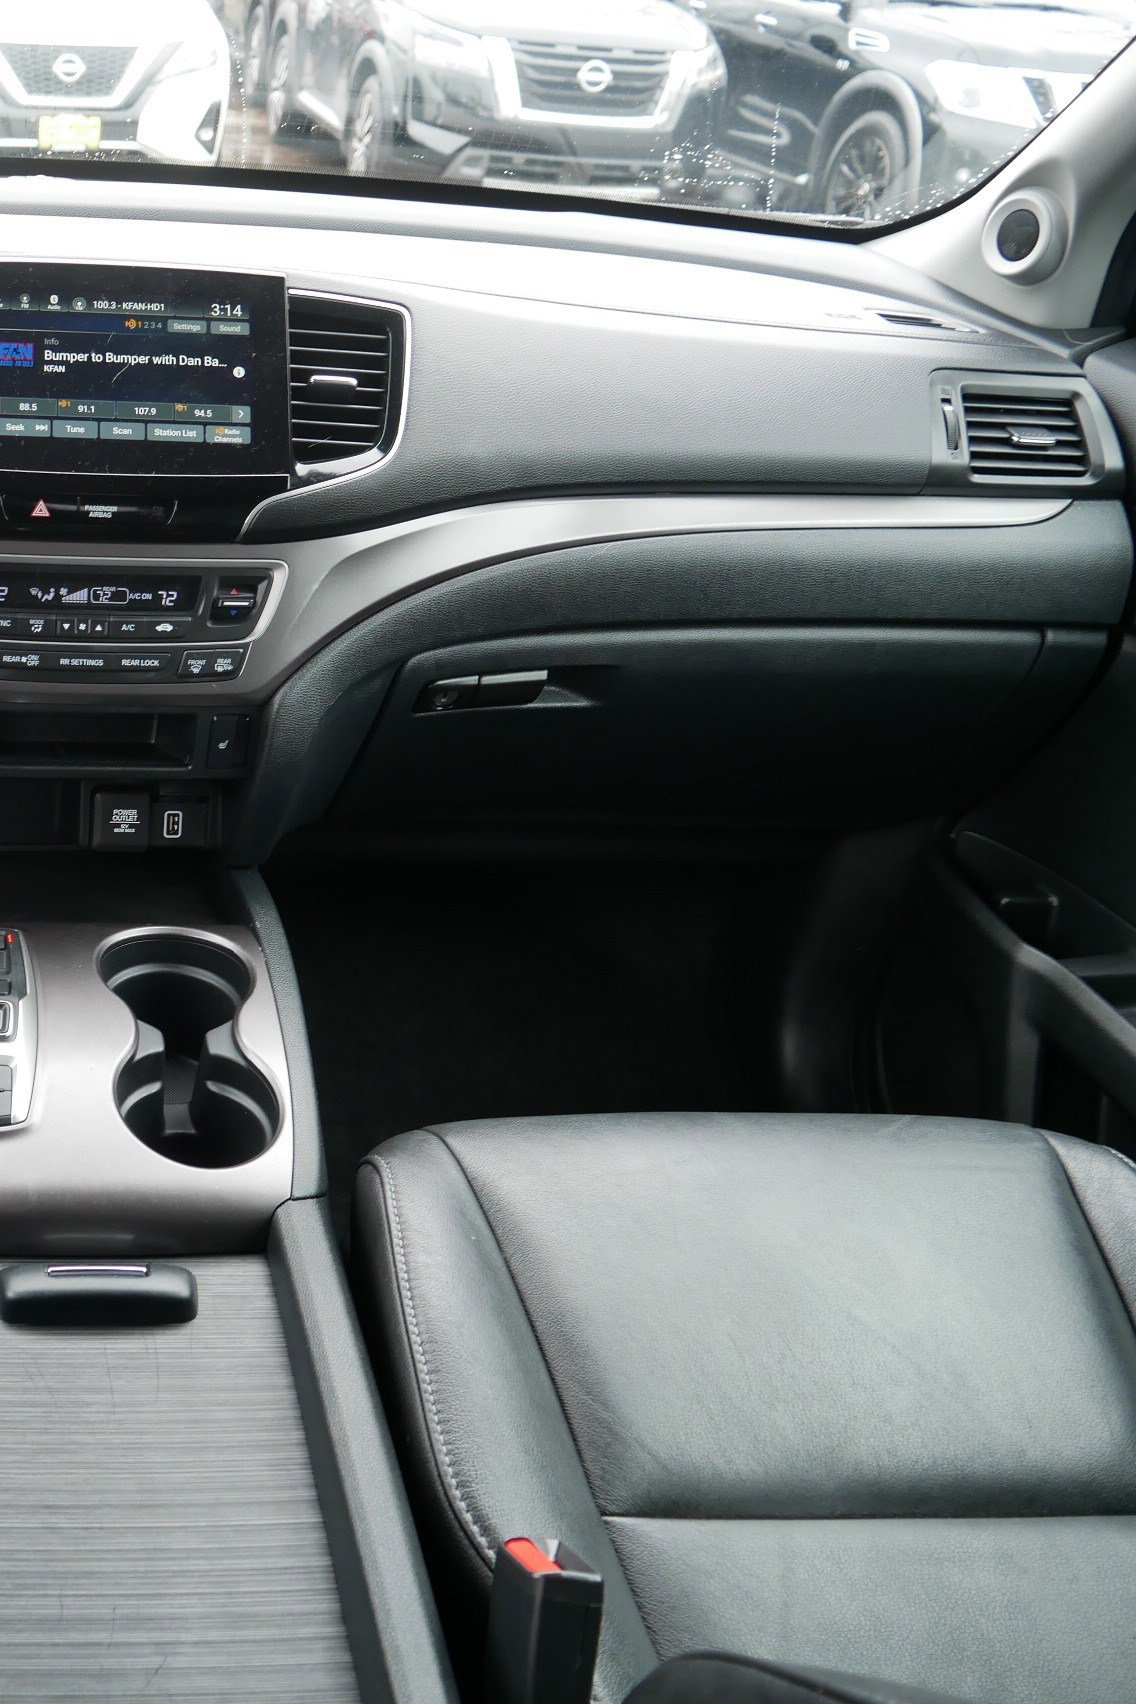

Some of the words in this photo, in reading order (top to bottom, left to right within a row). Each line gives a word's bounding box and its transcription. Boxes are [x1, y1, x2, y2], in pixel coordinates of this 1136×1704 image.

[93, 301, 116, 310] 100.3
[122, 302, 164, 311] KFAN-HD1
[211, 303, 242, 317] 3:14
[173, 322, 201, 331] Settings
[220, 325, 241, 333] Sound
[44, 338, 60, 346] Info
[44, 350, 89, 364] Bumper
[91, 353, 103, 362] to
[106, 353, 149, 365] Bumper
[152, 354, 177, 365] with
[179, 357, 202, 366] Dan
[44, 365, 65, 373] KFAN
[19, 403, 37, 411] 88.5
[78, 405, 95, 413] 91.1
[134, 407, 156, 415] 107.9
[194, 410, 212, 418] 94.5
[5, 423, 25, 431] Seek
[66, 426, 85, 434] Tune
[113, 427, 133, 435] Scan
[154, 428, 181, 437] Station
[183, 429, 197, 437] List
[158, 591, 178, 606] 72
